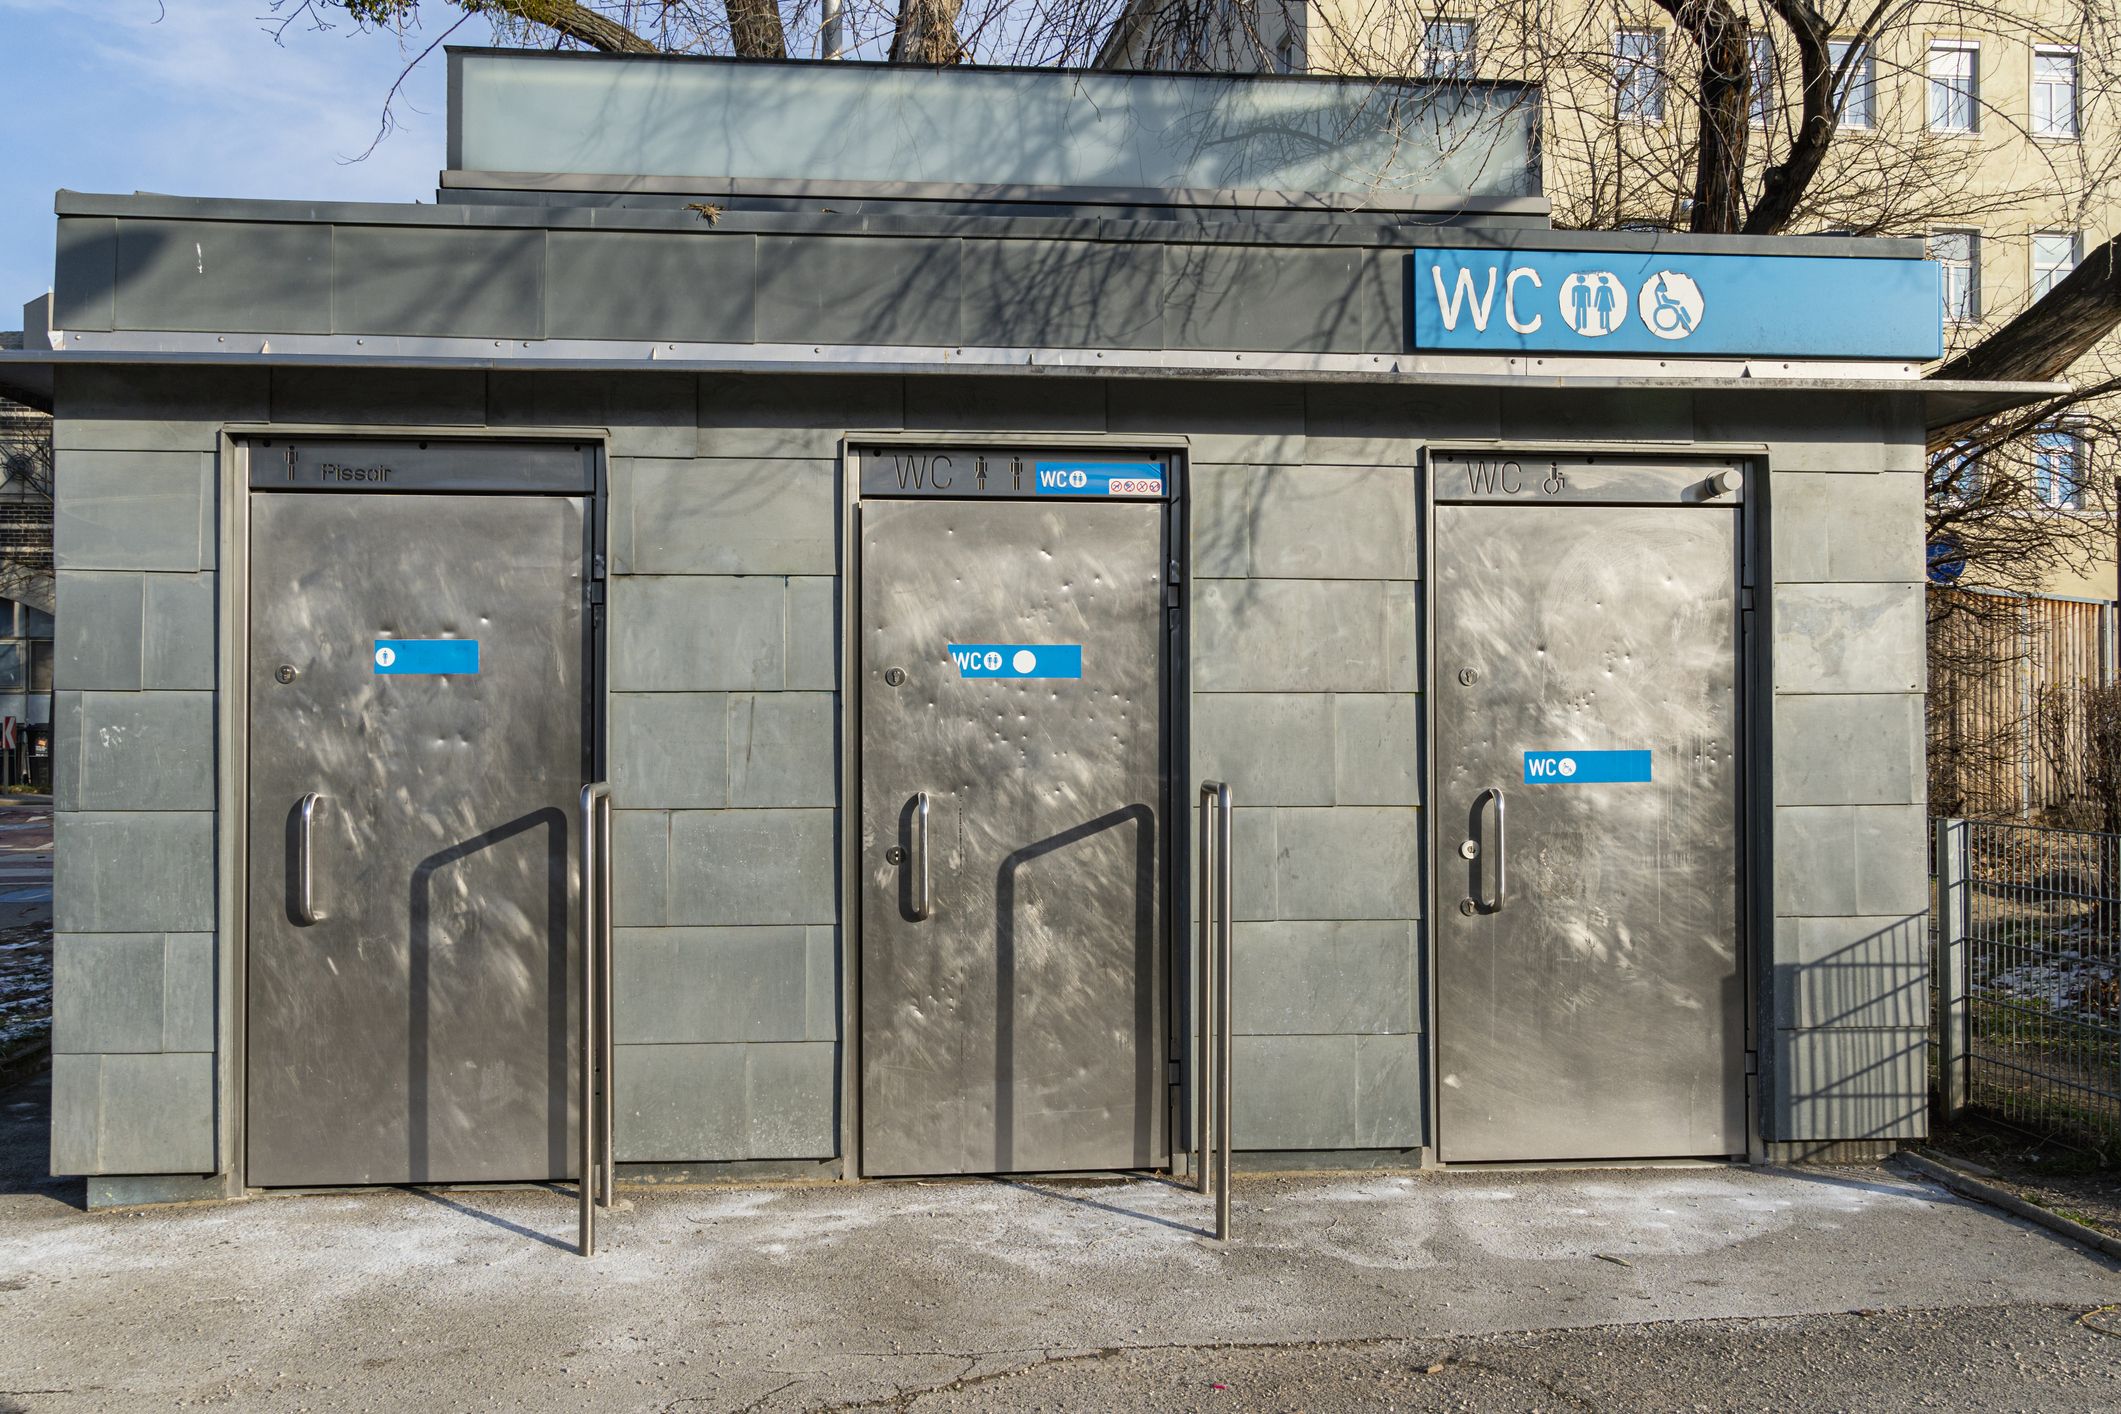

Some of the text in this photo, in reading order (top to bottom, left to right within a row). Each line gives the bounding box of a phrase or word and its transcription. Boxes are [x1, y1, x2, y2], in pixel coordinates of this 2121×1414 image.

[1431, 265, 1542, 334] WC
[321, 463, 392, 482] Pissoir
[894, 454, 952, 490] WC
[1040, 471, 1067, 488] WC
[1466, 460, 1522, 494] WC
[952, 651, 982, 670] WC
[1528, 758, 1556, 776] WC
